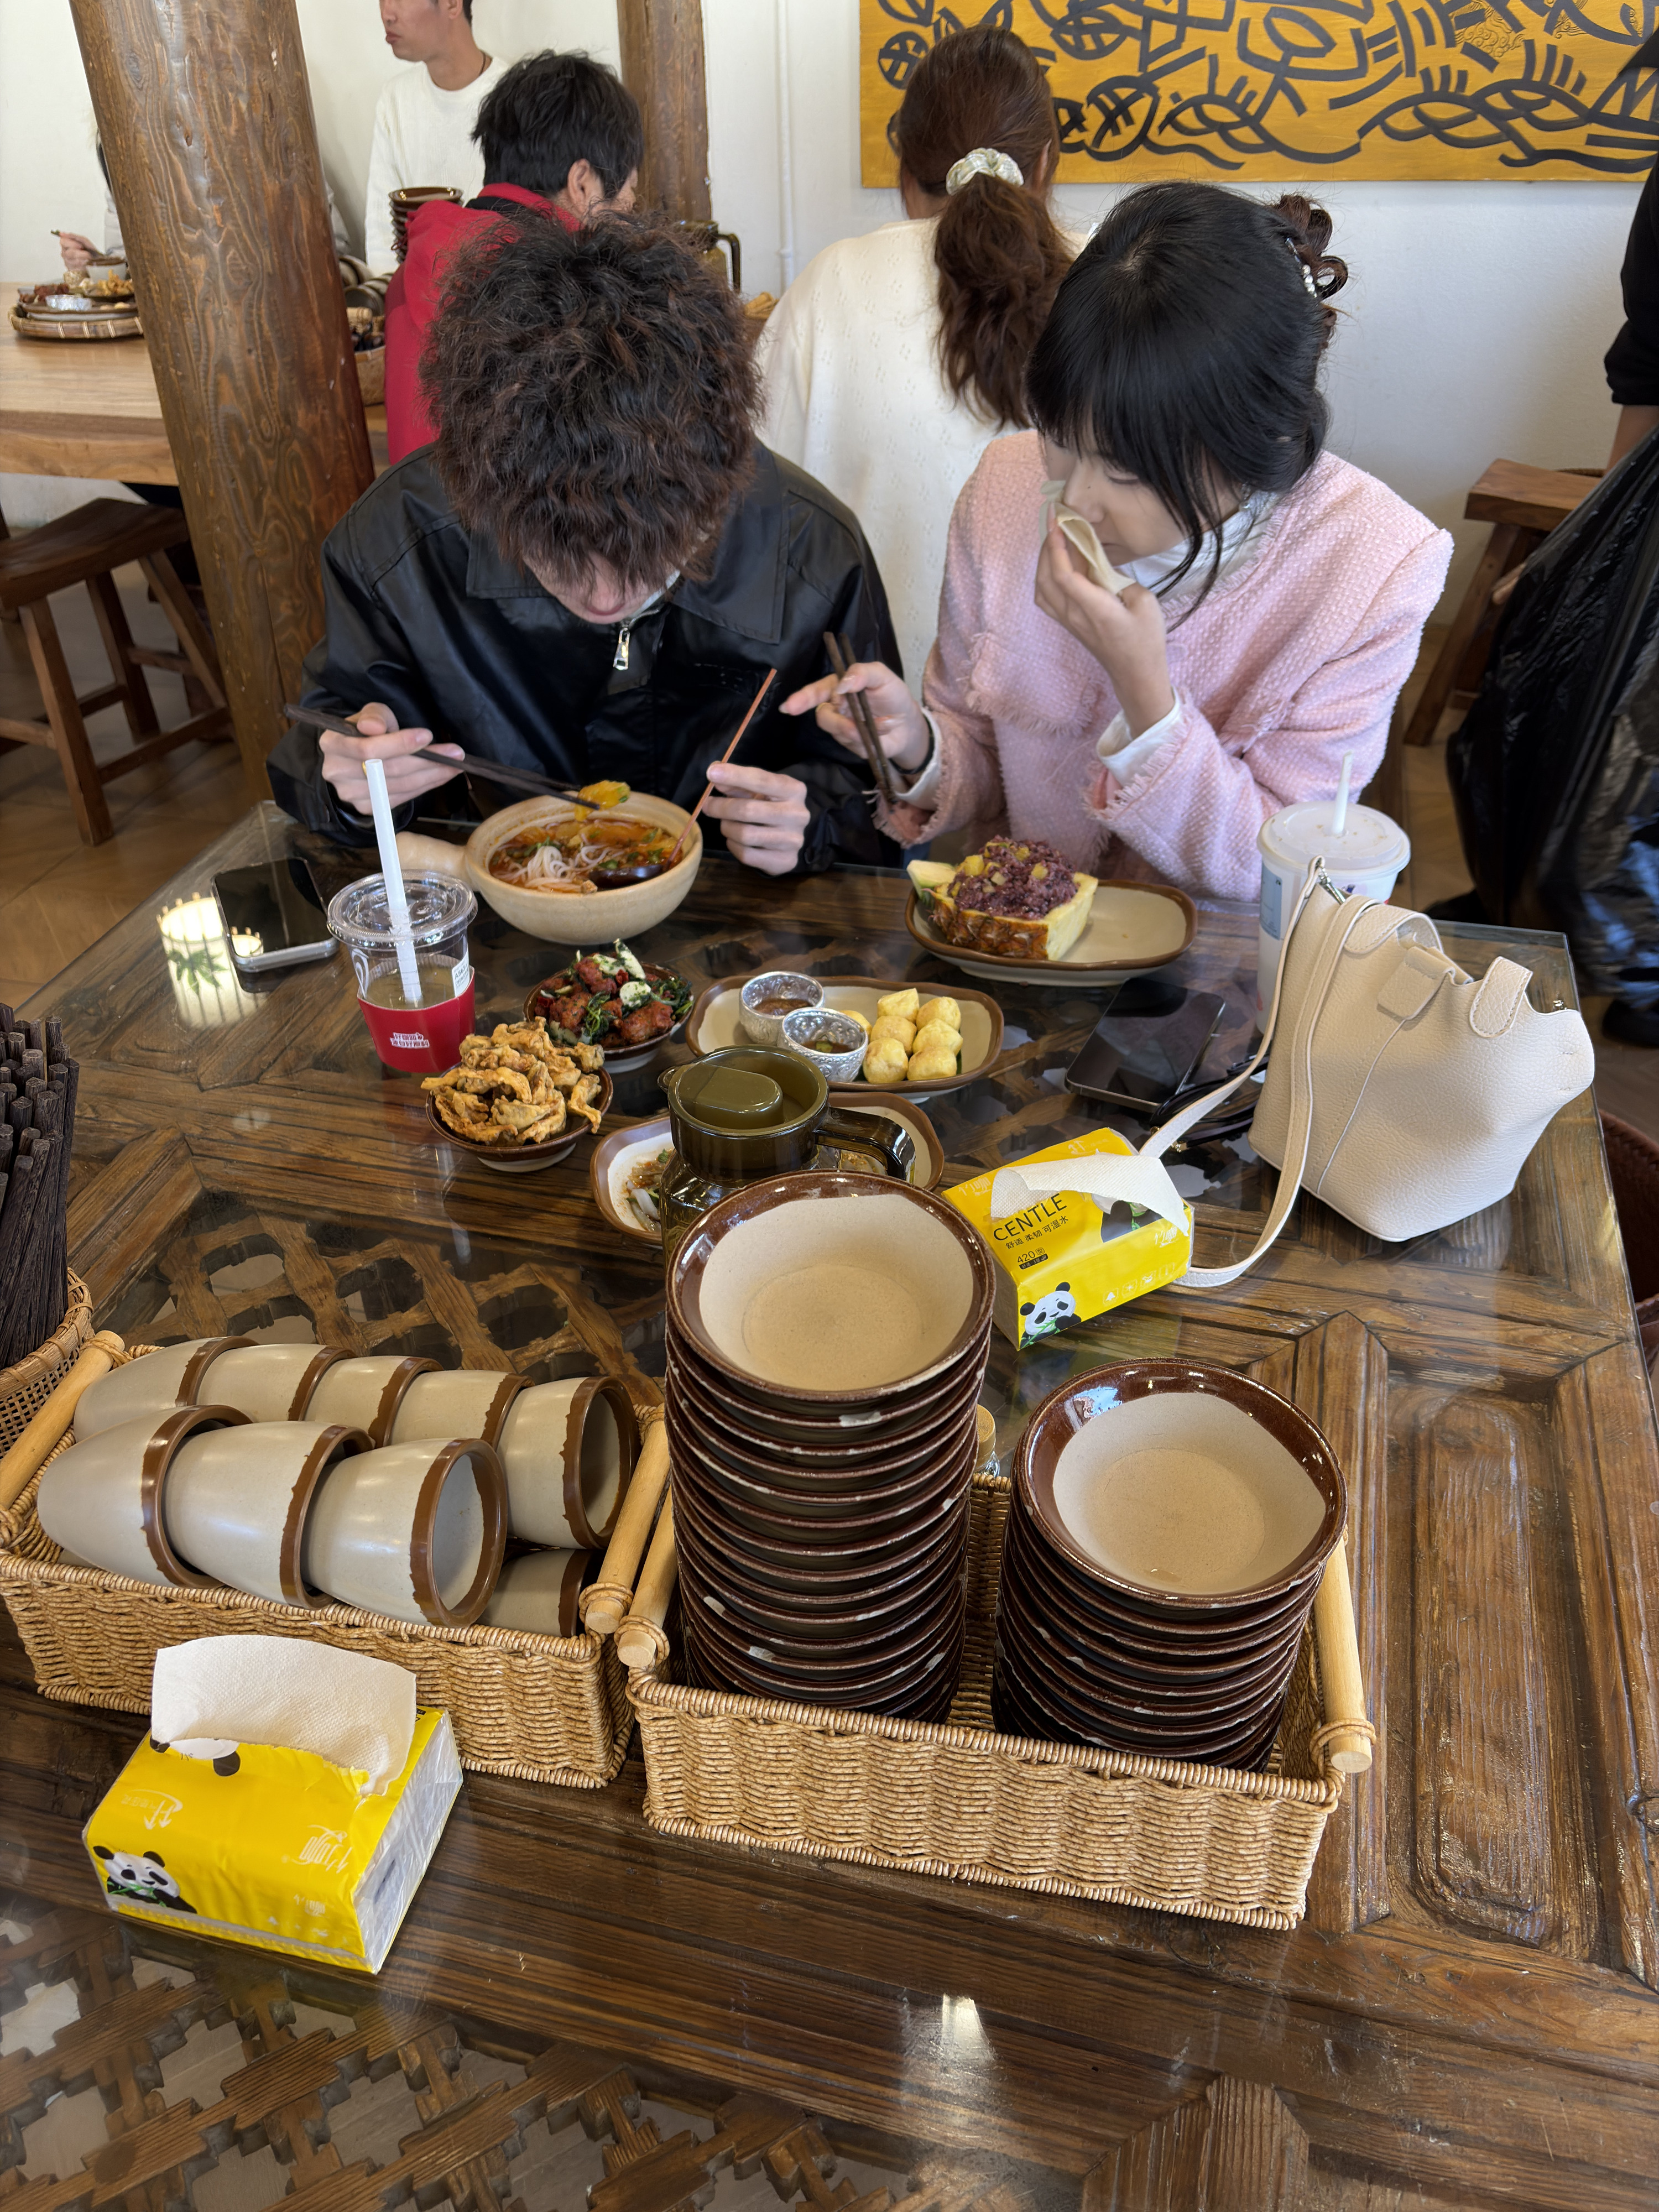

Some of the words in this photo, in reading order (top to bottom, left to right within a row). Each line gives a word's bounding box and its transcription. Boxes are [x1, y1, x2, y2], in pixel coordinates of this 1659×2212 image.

[1005, 1238, 1024, 1249] 舒适
[1024, 1229, 1043, 1241] 柔韧
[1042, 1215, 1069, 1234] 可湿水
[1017, 1250, 1035, 1264] 420
